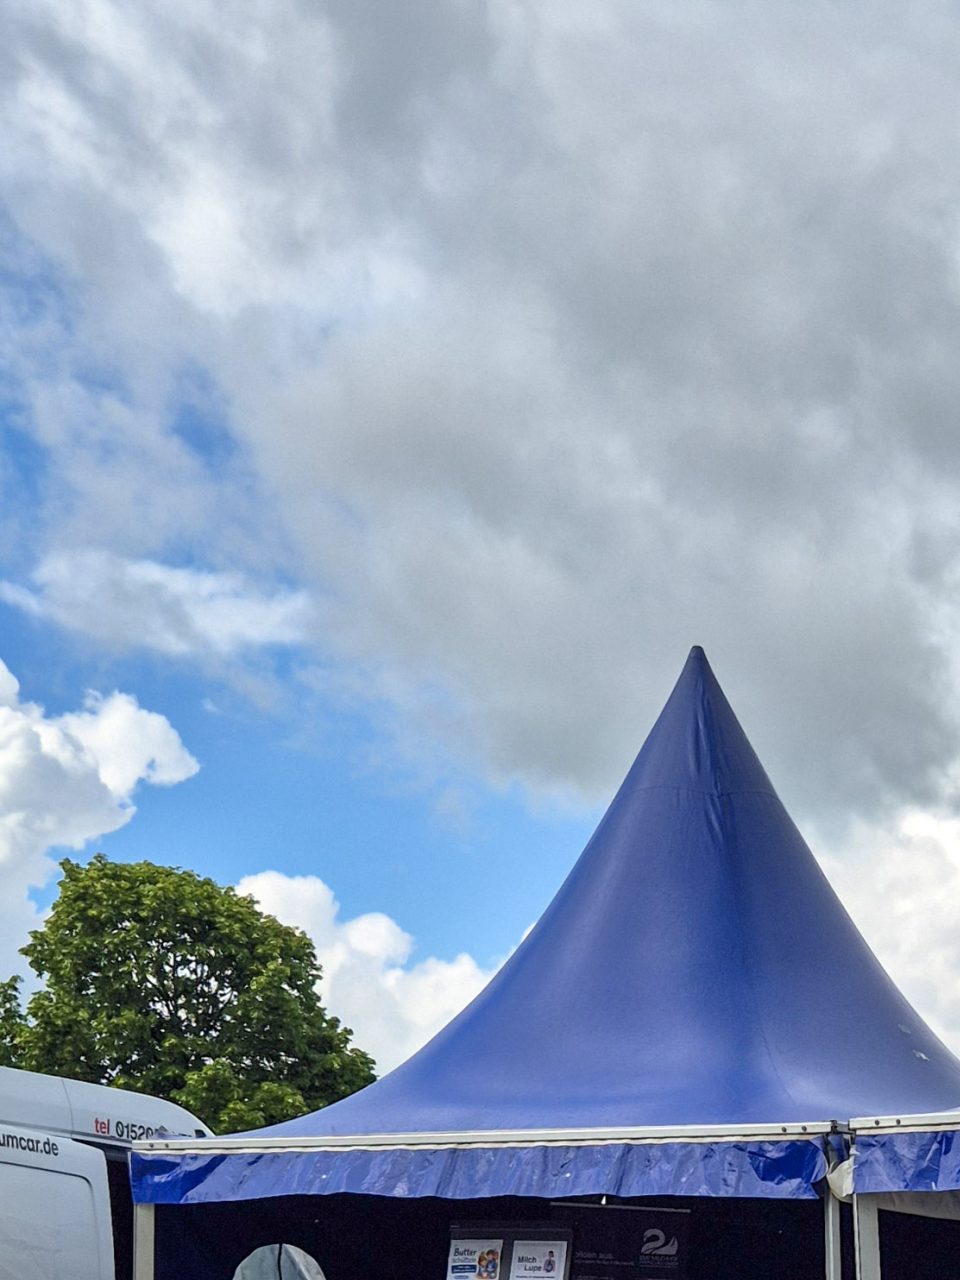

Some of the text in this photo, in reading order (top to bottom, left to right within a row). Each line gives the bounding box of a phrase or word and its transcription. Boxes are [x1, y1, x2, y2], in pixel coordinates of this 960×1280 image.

[94, 1117, 110, 1135] tel
[453, 1247, 477, 1257] Butter
[517, 1255, 537, 1263] Milch
[524, 1263, 542, 1272] Lupe
